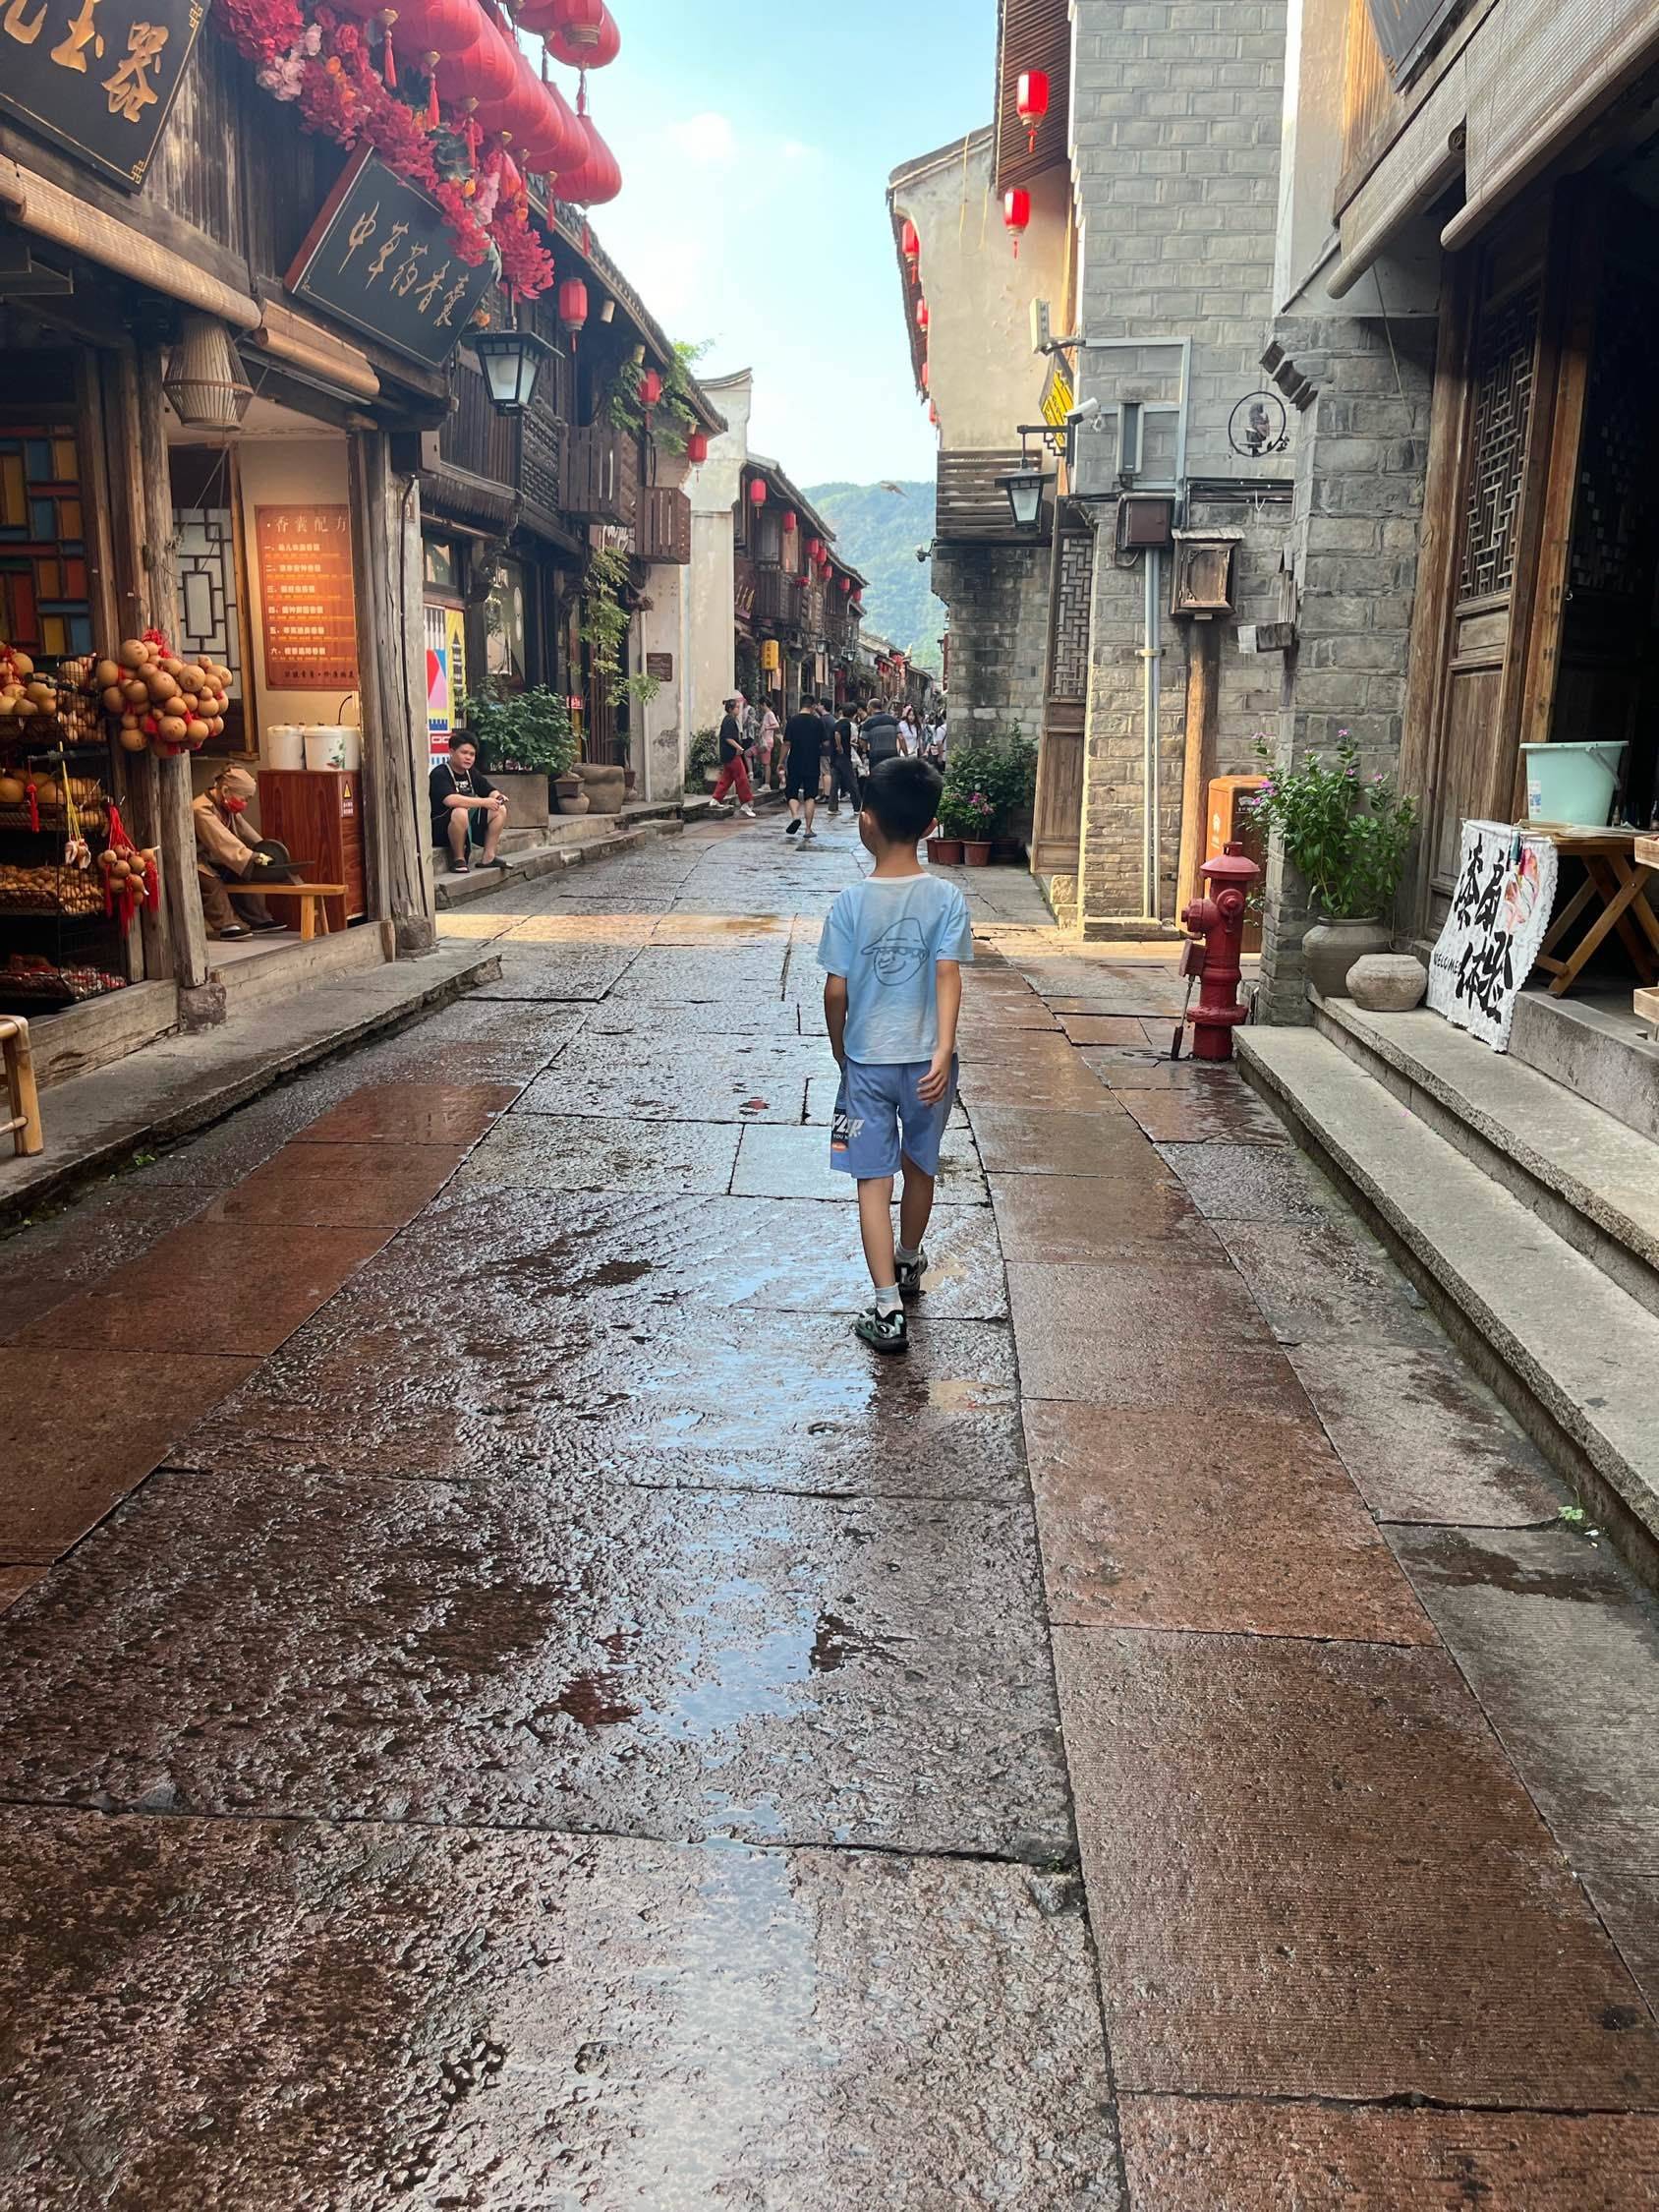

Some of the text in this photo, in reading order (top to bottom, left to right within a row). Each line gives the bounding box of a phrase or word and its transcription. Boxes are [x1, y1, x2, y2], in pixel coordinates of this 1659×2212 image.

[338, 201, 469, 326] 中草药香囊
